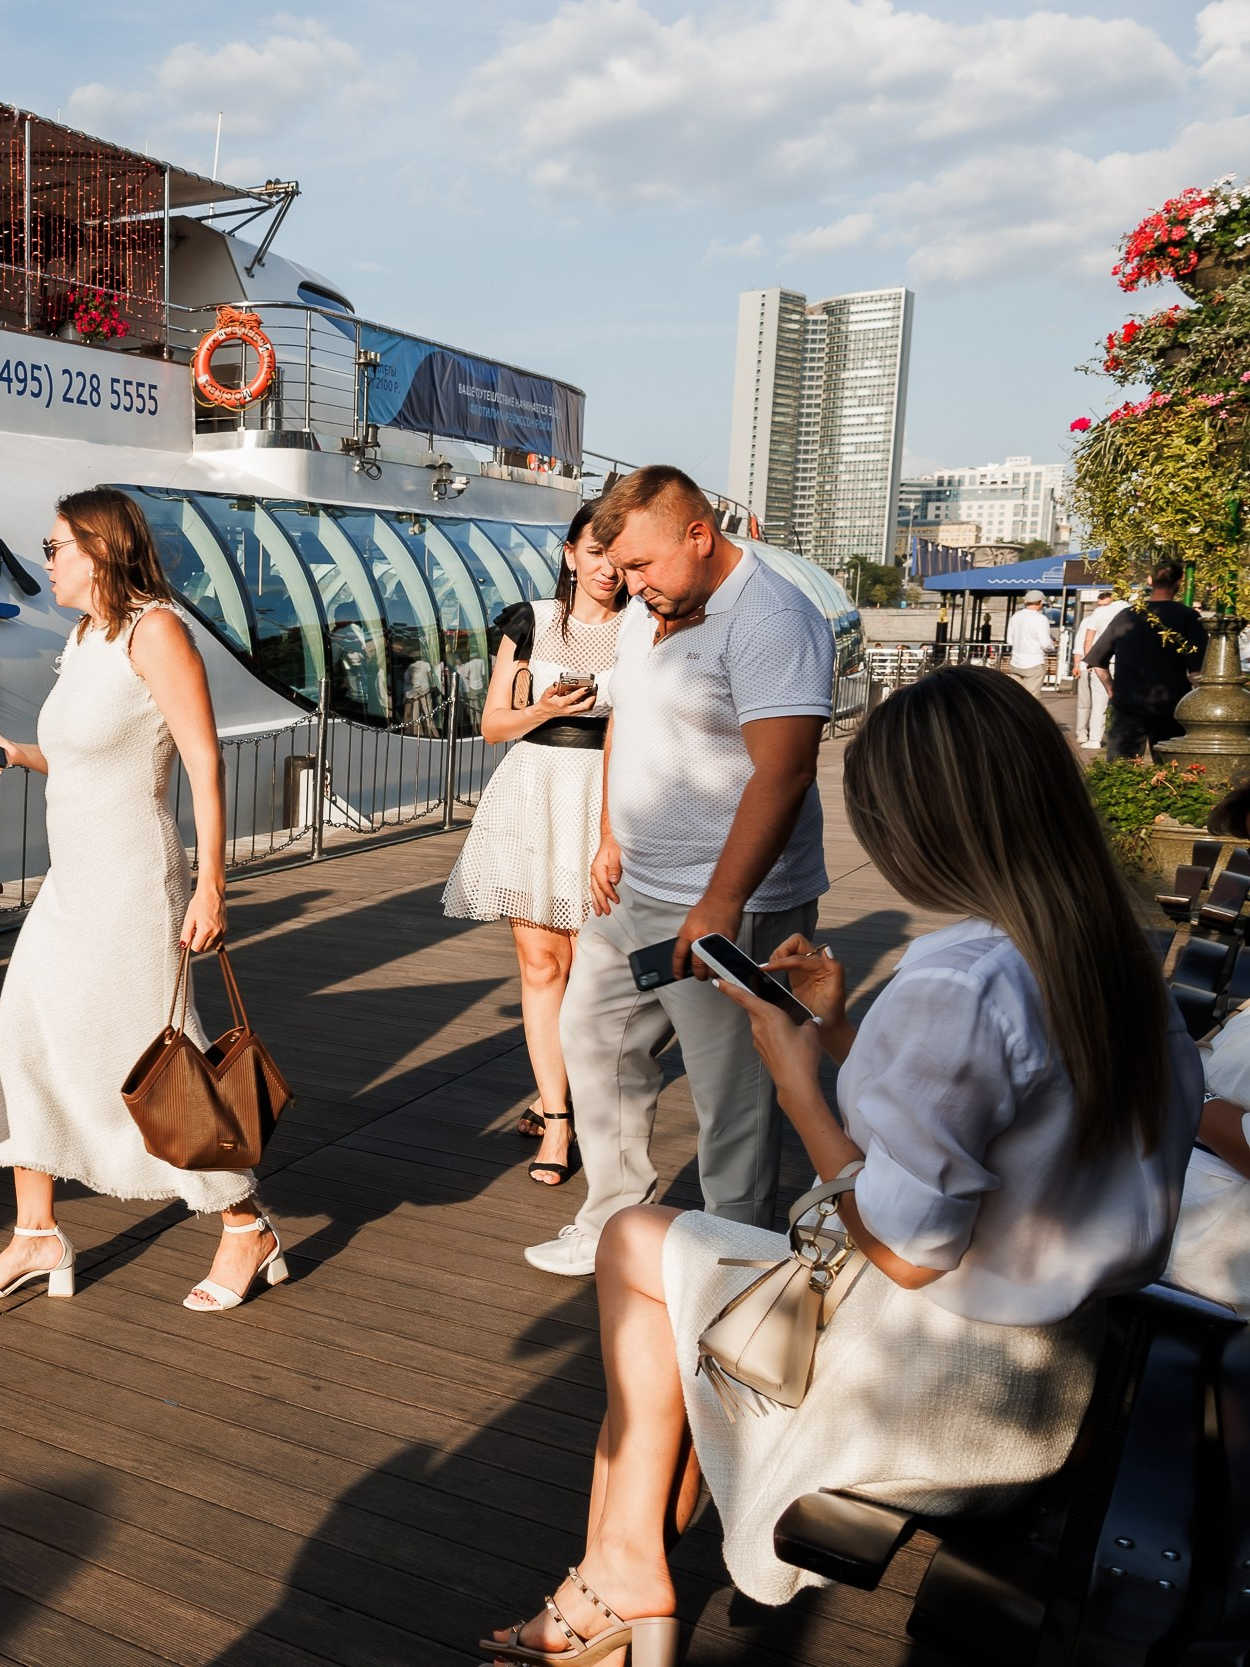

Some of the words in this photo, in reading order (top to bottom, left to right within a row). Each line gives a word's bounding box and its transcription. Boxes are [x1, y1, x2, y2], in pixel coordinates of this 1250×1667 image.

[61, 368, 102, 408] 228
[110, 377, 159, 416] 5555
[376, 376, 393, 392] 2100
